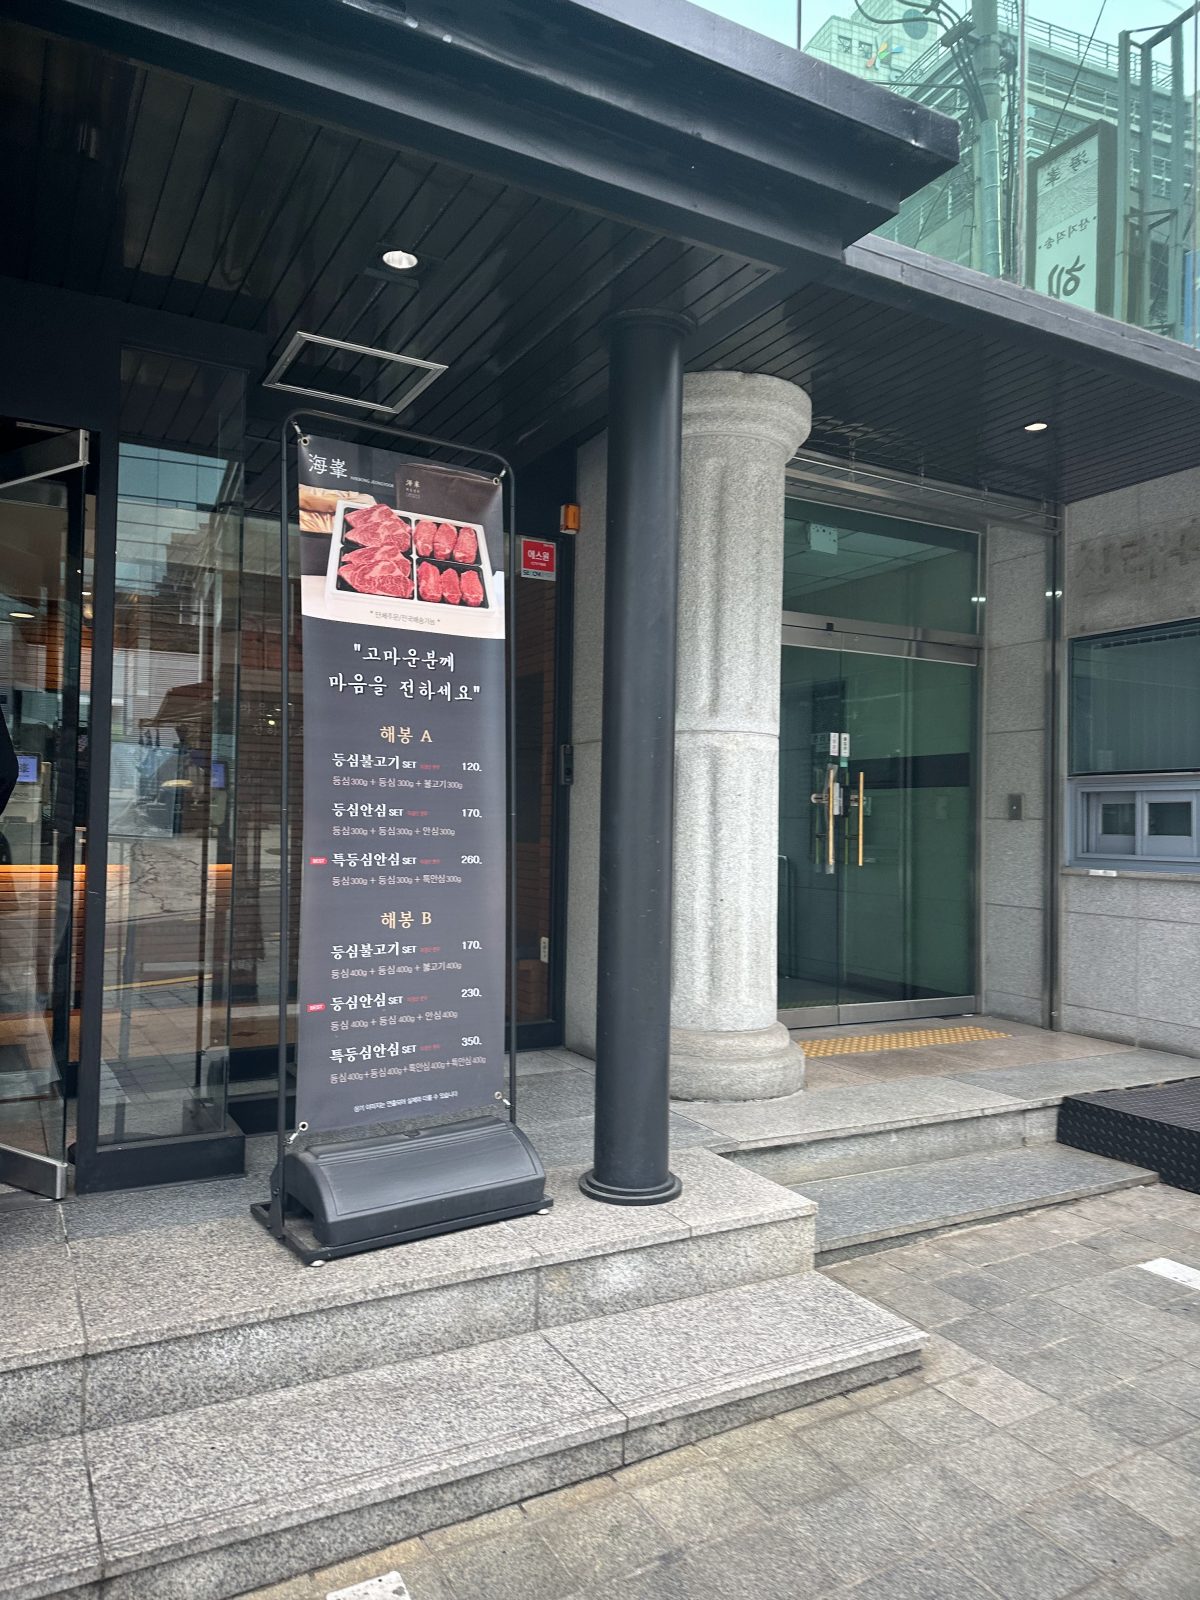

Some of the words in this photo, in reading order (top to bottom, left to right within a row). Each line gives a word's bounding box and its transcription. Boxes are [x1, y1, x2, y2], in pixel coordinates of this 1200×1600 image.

[329, 673, 387, 695] 마음을
[380, 726, 413, 744] 해봉
[420, 730, 432, 742] A
[332, 753, 399, 769] 등심불고기
[332, 803, 386, 817] 등심안심
[331, 852, 399, 867] 특등심안심
[380, 911, 414, 929] 해봉
[422, 912, 431, 924] B
[331, 942, 399, 960] 등심불고기
[330, 993, 385, 1011] 등심안심
[388, 996, 403, 1004] SET
[329, 1042, 399, 1063] 특등심안심
[402, 1045, 416, 1053] SET
